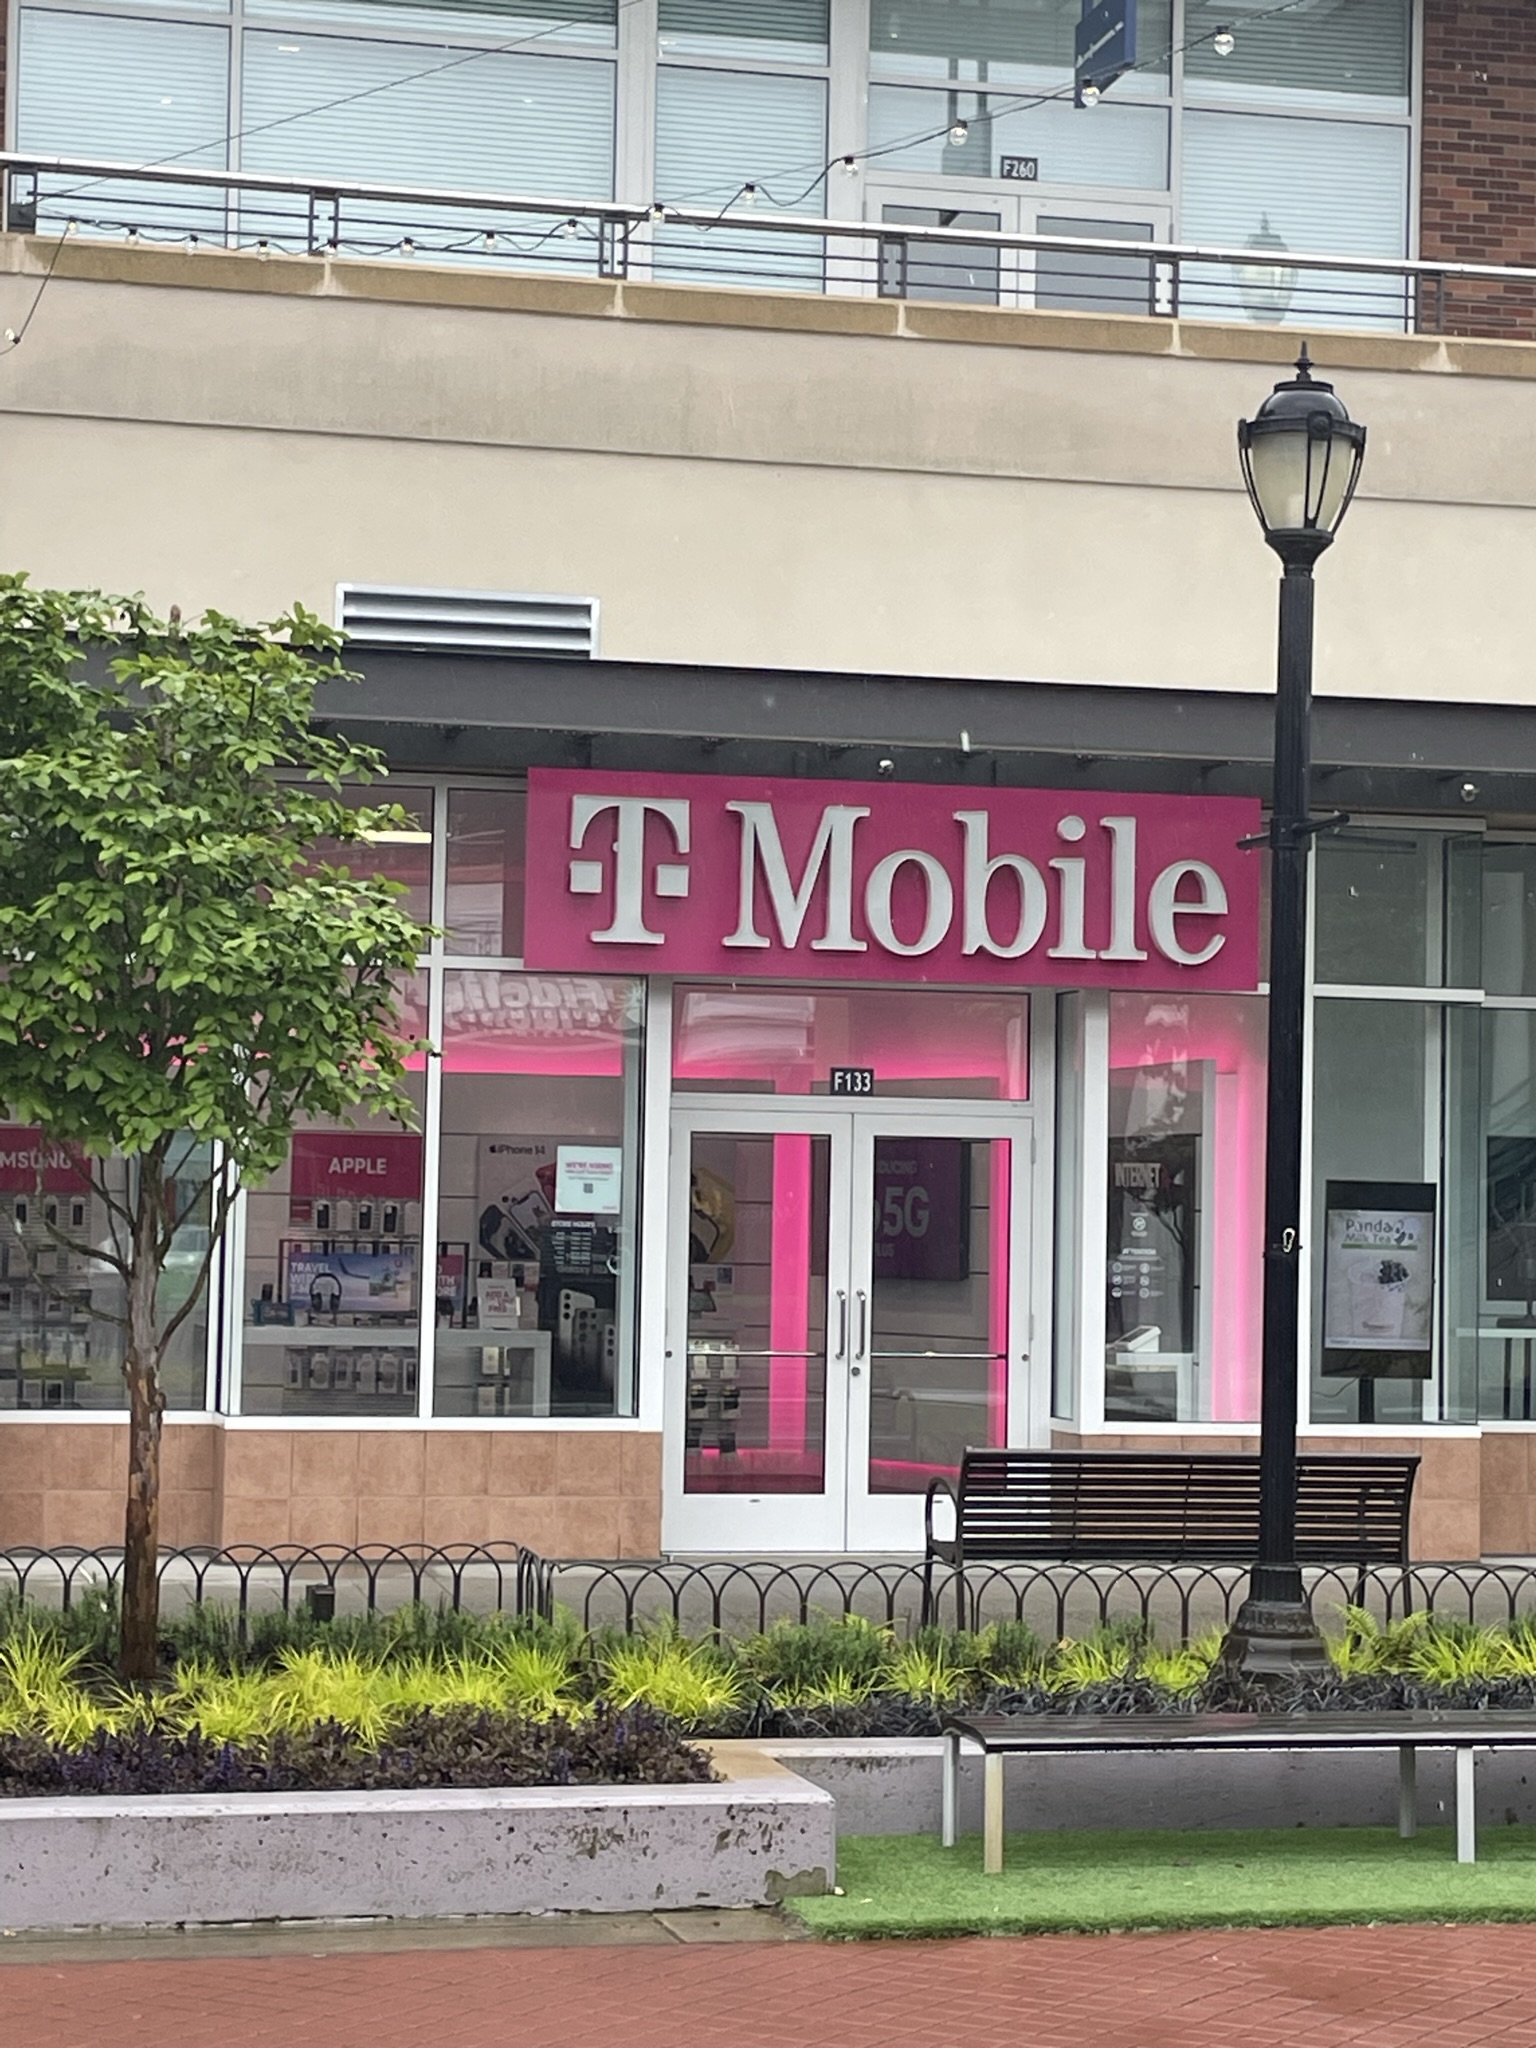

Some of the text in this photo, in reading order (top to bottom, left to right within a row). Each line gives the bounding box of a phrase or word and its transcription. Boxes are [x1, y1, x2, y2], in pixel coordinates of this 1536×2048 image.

[1002, 160, 1035, 179] F260
[722, 799, 1230, 967] Mobile
[833, 1071, 872, 1093] F133
[328, 1156, 387, 1175] APPLE
[1345, 1218, 1393, 1234] Panda
[1372, 1233, 1392, 1245] Tea
[290, 1261, 332, 1273] TRAVEL
